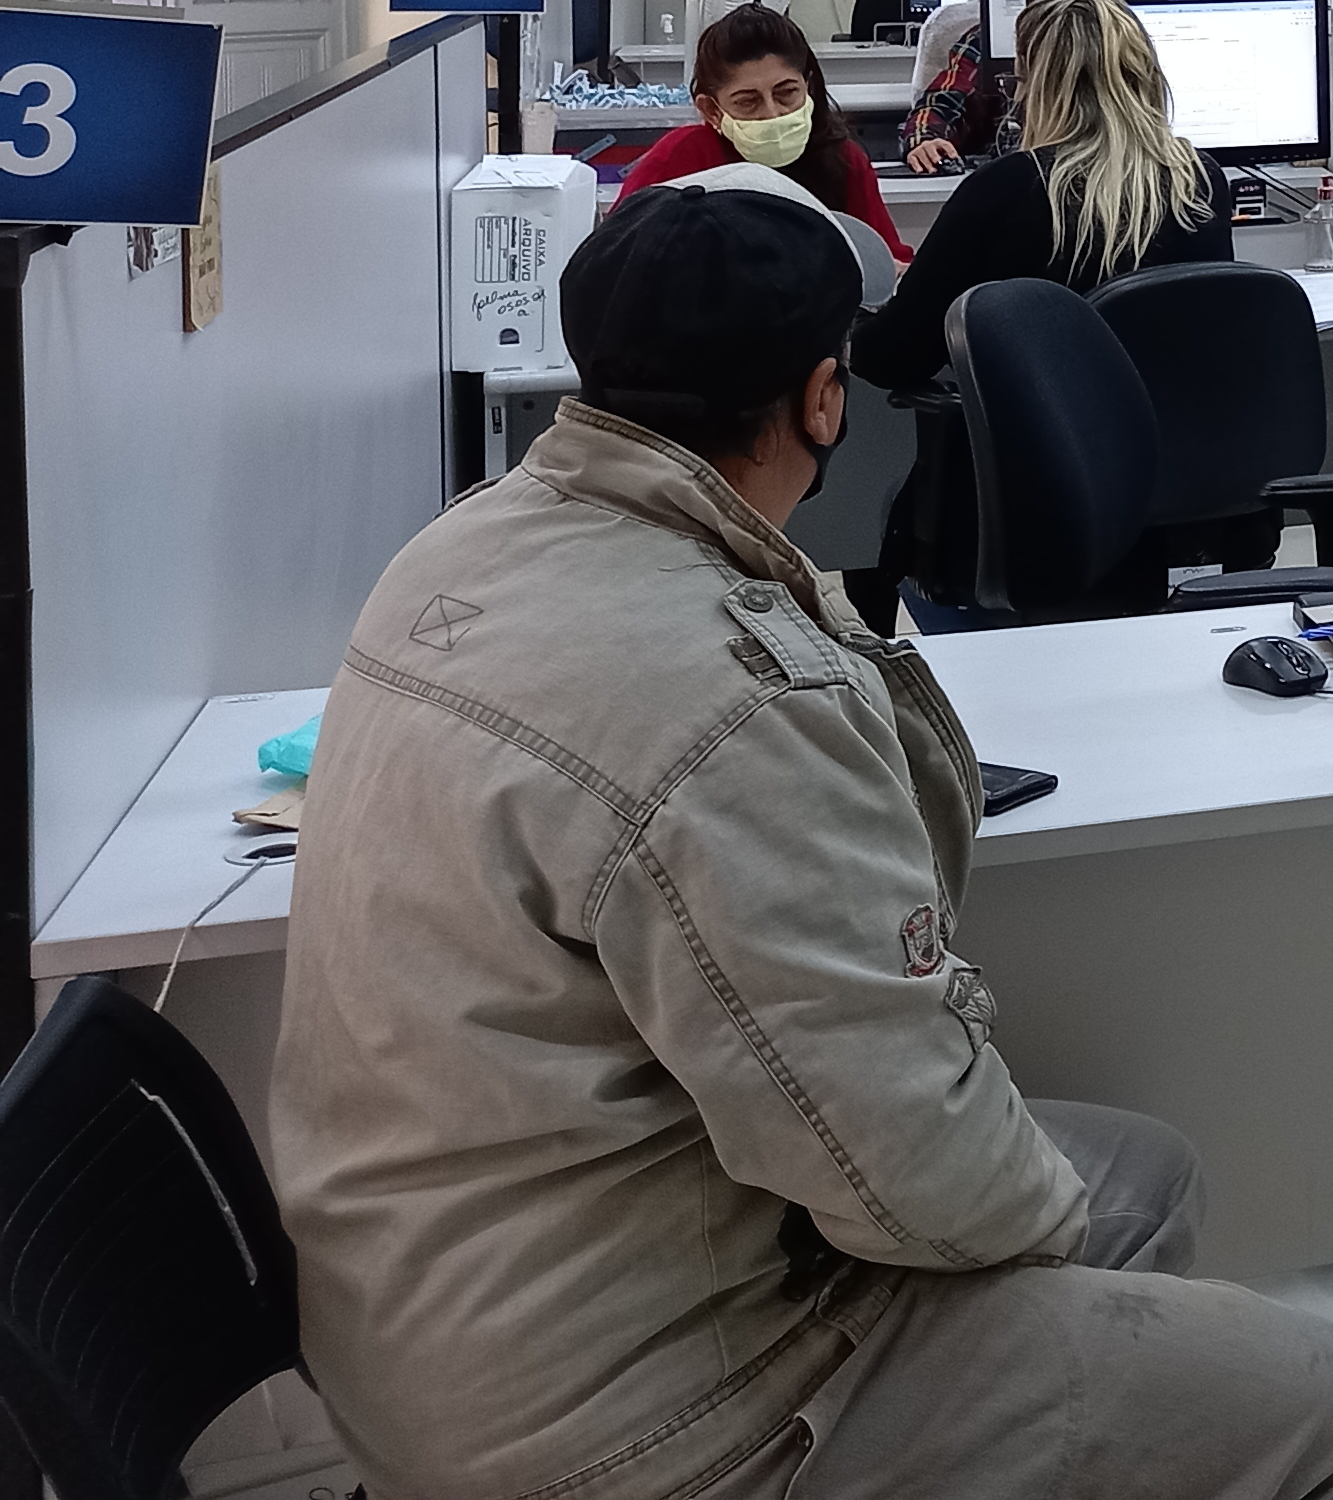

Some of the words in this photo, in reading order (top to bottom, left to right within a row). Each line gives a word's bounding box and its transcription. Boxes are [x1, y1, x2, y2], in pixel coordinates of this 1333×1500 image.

[0, 63, 77, 177] 3
[521, 218, 532, 282] ARQUIVO
[537, 228, 547, 268] CAIXA
